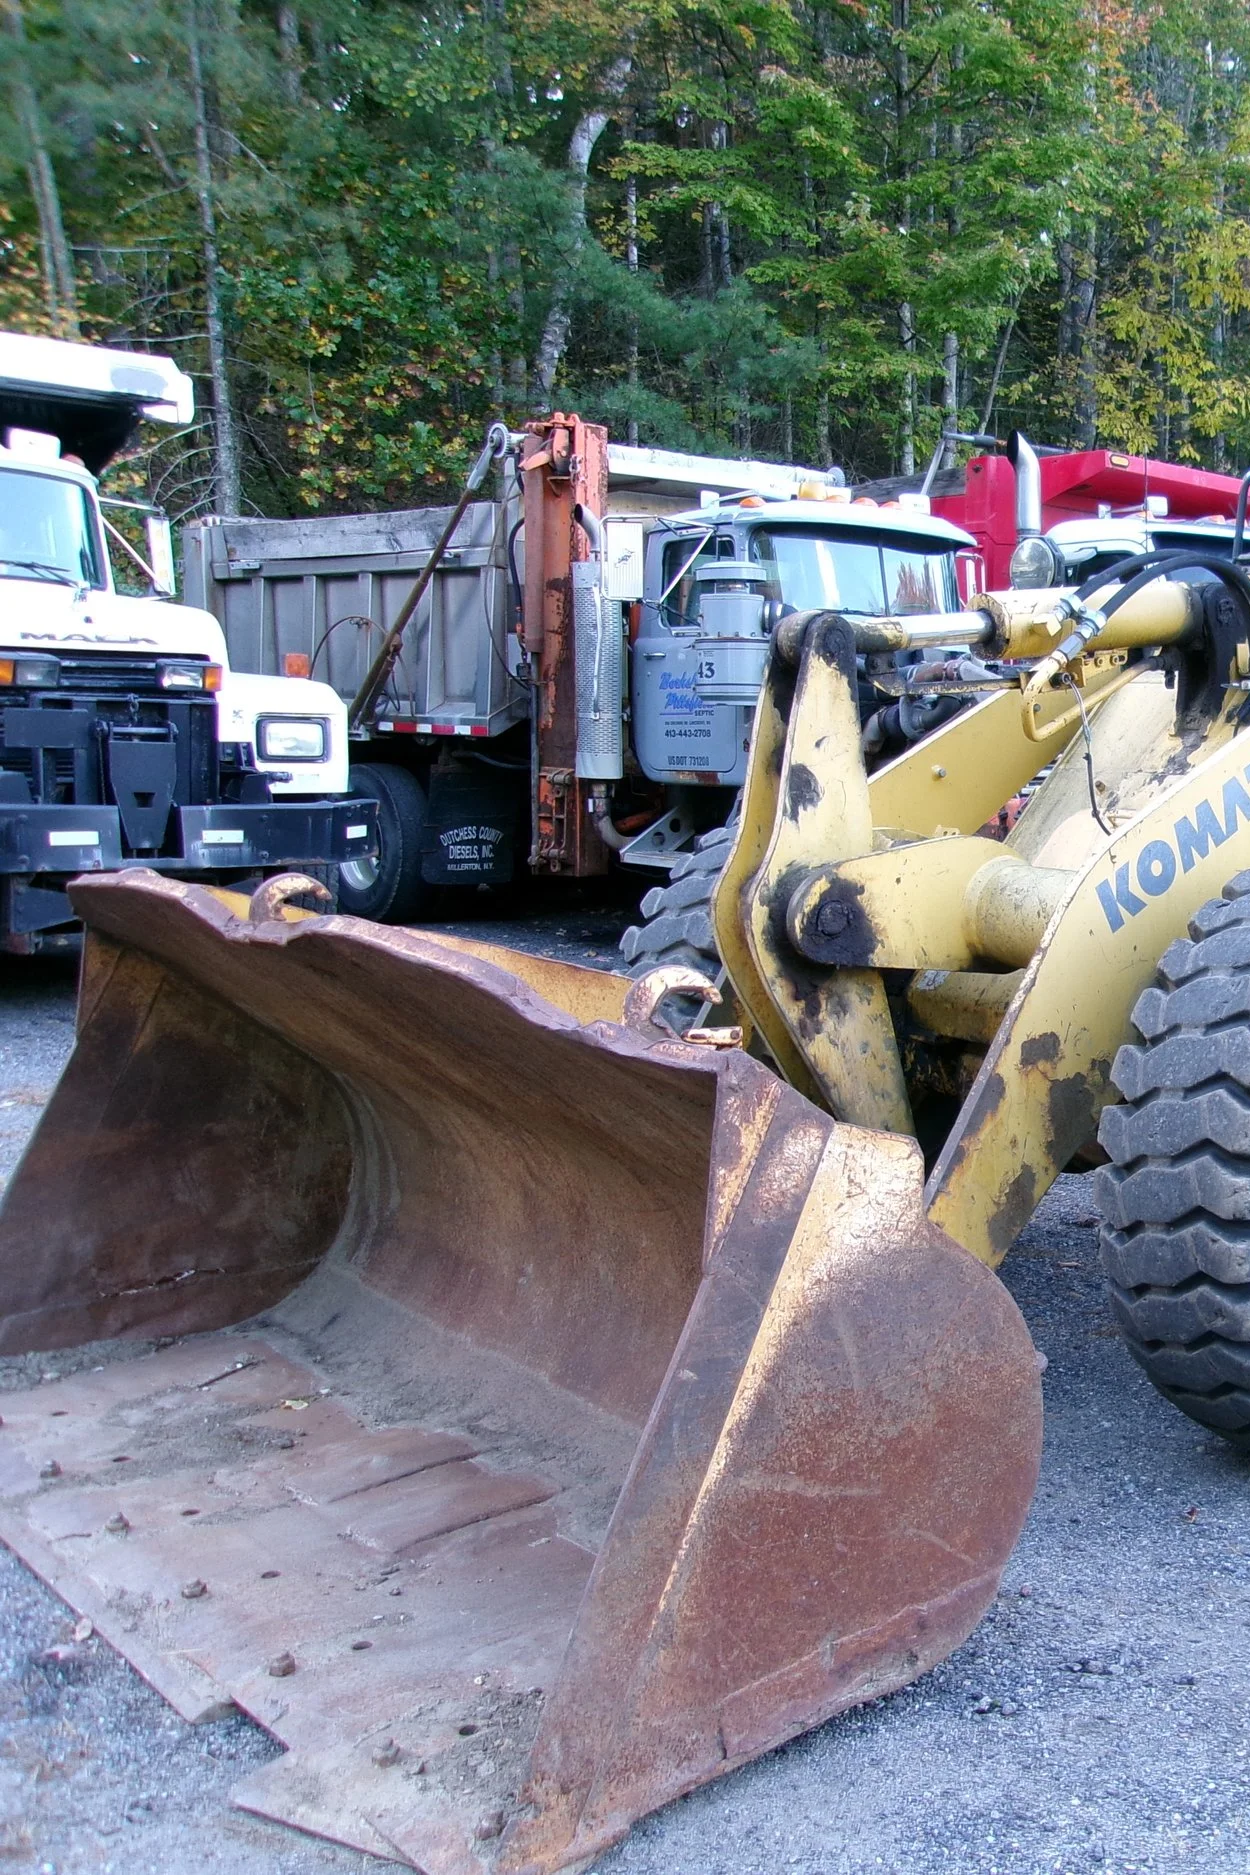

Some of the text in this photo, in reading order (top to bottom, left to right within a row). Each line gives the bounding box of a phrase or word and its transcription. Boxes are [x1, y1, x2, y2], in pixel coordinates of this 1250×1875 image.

[694, 709, 715, 717] SEPTIC
[664, 729, 712, 738] 413-443-2708
[440, 826, 504, 846] DUTCHESS COUNTY
[449, 844, 495, 861] DIESELS, INC.
